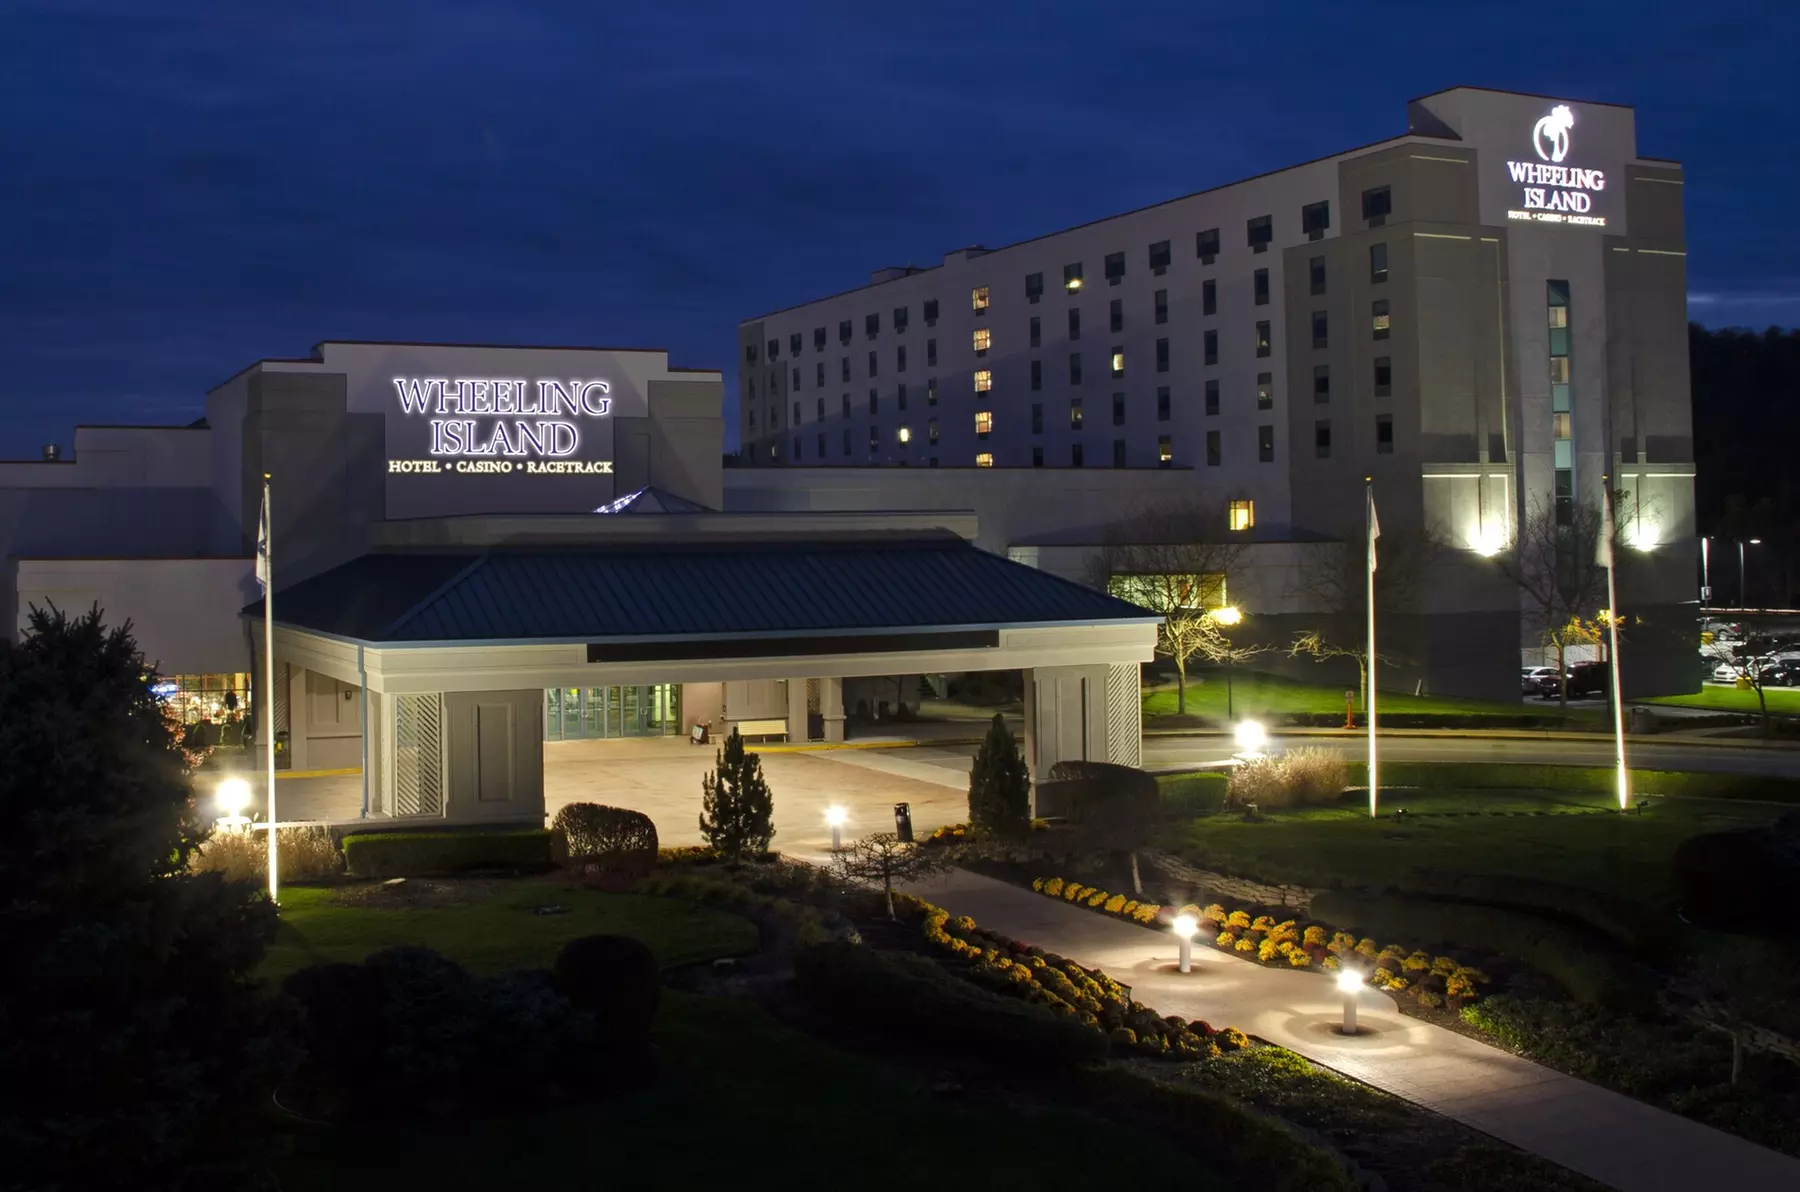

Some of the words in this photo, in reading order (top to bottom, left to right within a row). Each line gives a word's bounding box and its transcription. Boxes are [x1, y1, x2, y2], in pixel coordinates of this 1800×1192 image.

[1507, 161, 1605, 191] WHEELING
[1524, 188, 1591, 213] ISLAND
[1537, 212, 1562, 222] CAO
[393, 378, 611, 416] WHEELING
[430, 420, 579, 456] ISLAND
[388, 460, 441, 473] HOTEL
[456, 461, 512, 473] CASINO
[527, 461, 614, 473] RACETRACK
